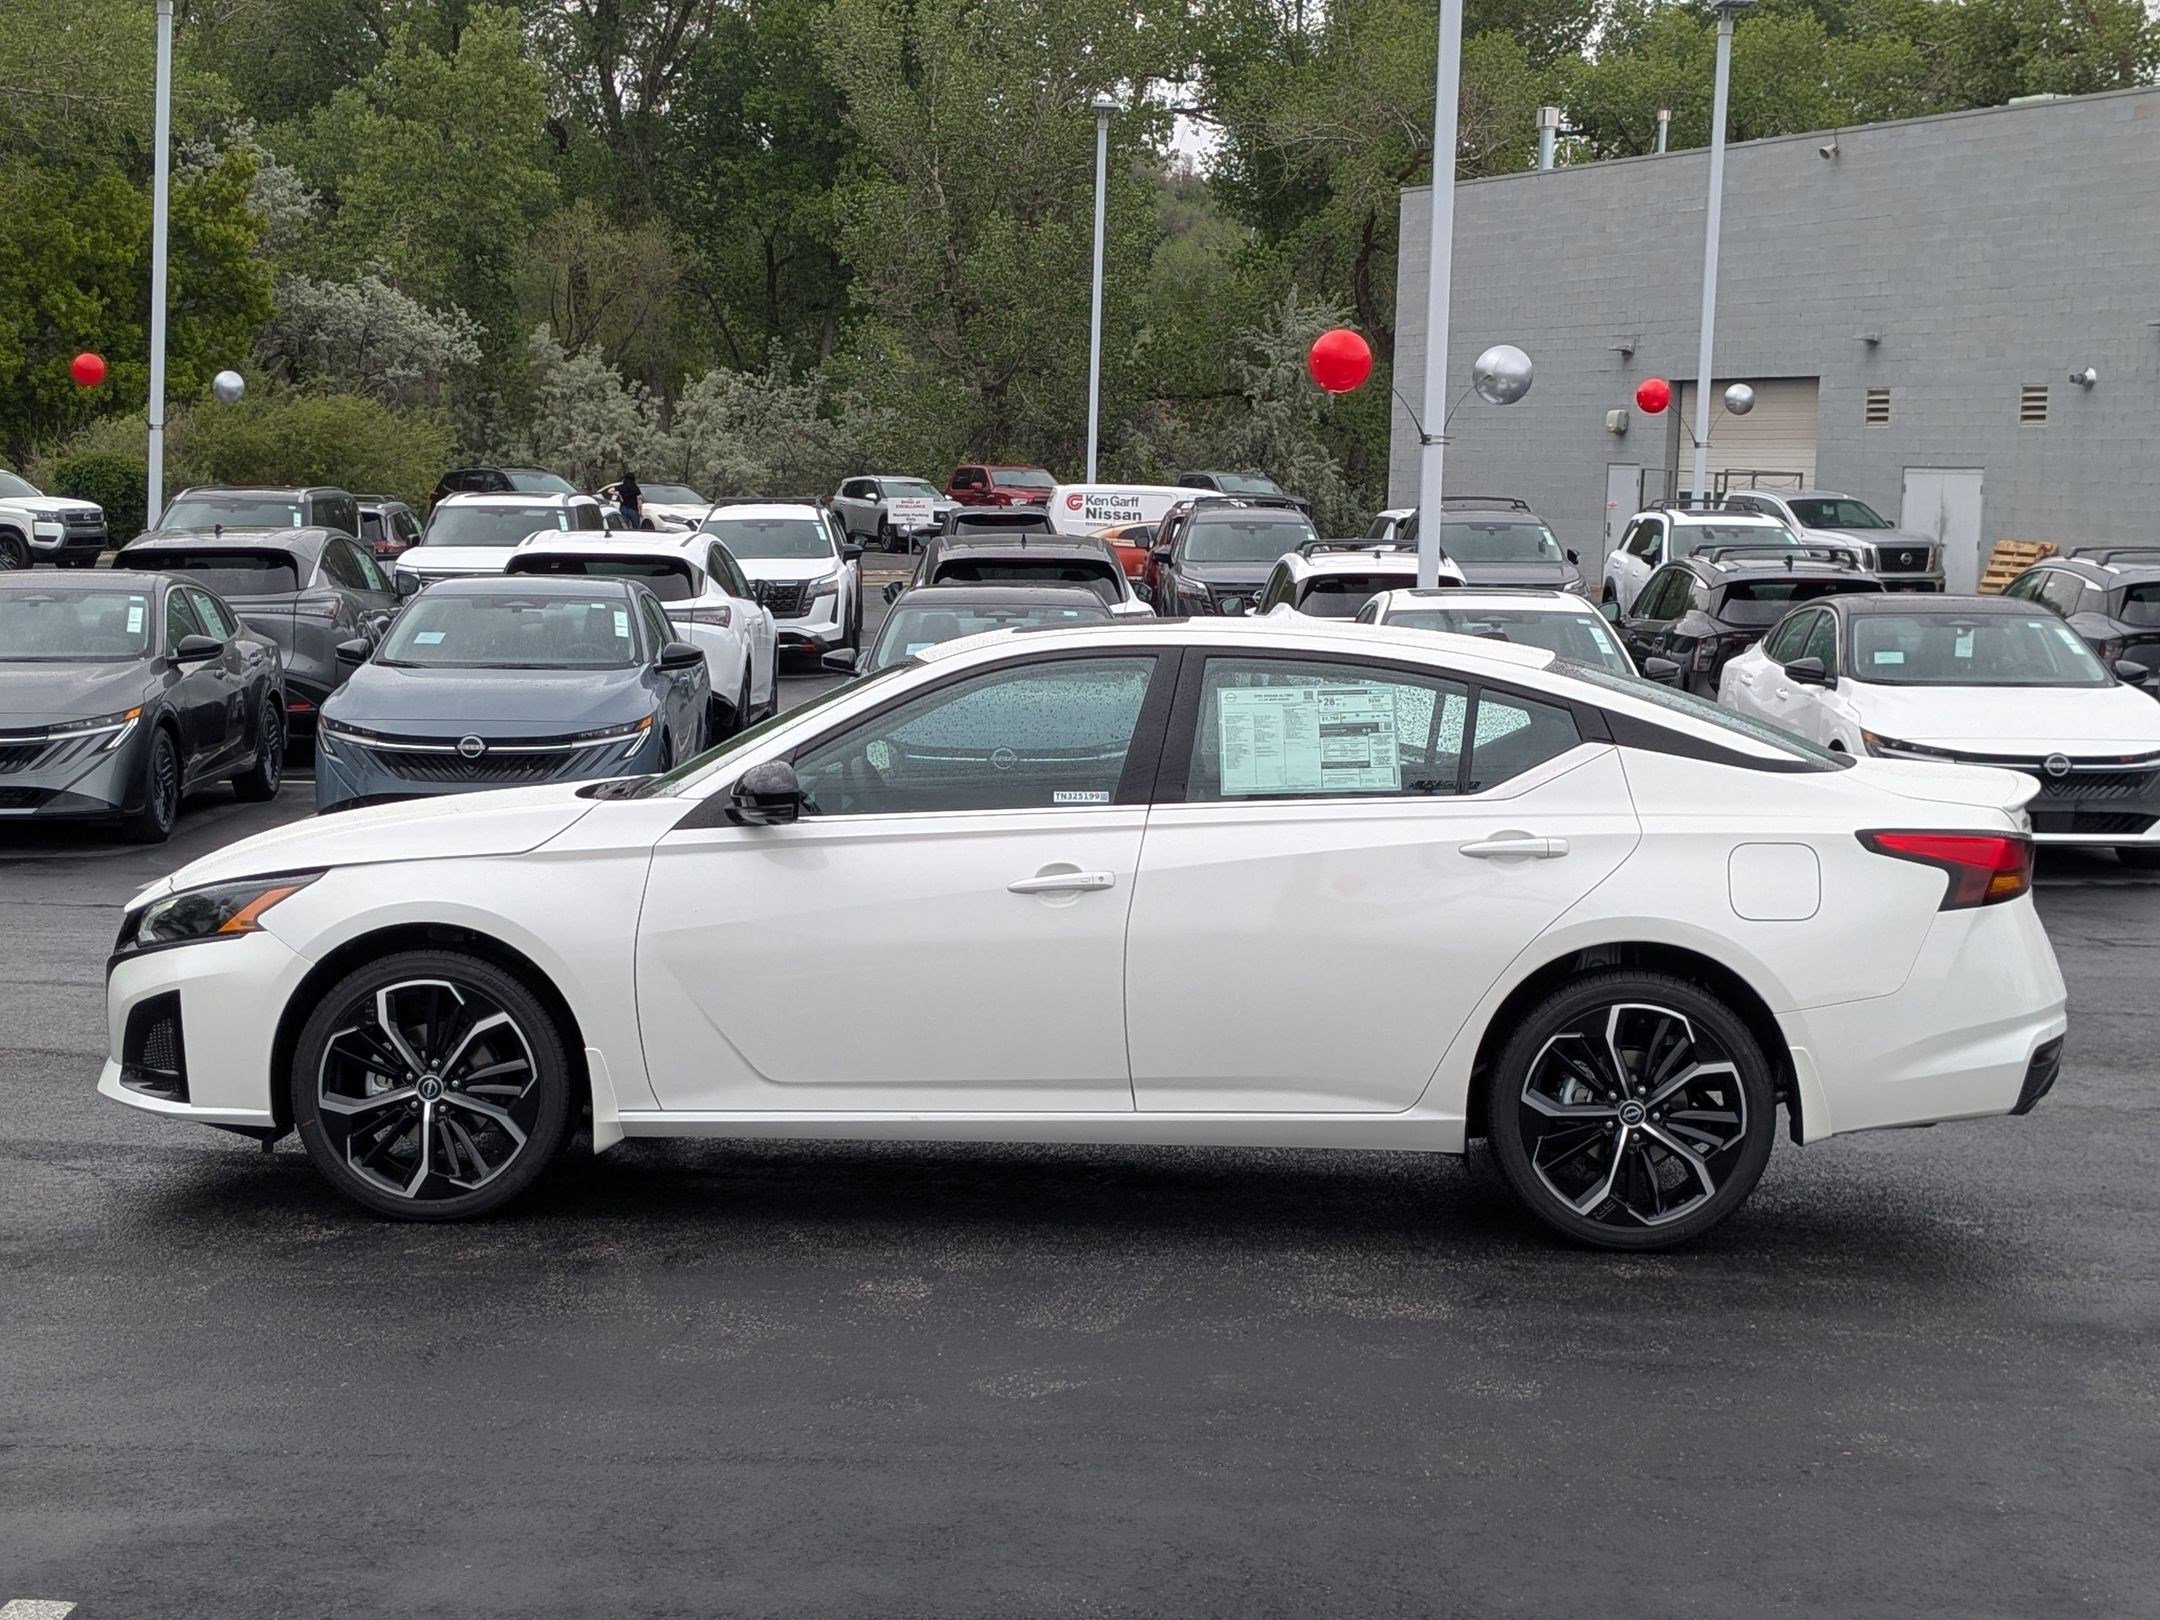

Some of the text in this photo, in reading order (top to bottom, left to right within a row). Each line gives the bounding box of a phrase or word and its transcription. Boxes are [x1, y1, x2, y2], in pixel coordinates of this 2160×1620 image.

[1085, 494, 1139, 508] Ken Garff
[1085, 507, 1142, 521] Nissan
[1323, 697, 1335, 706] 28
[1055, 792, 1100, 801] TN325199
